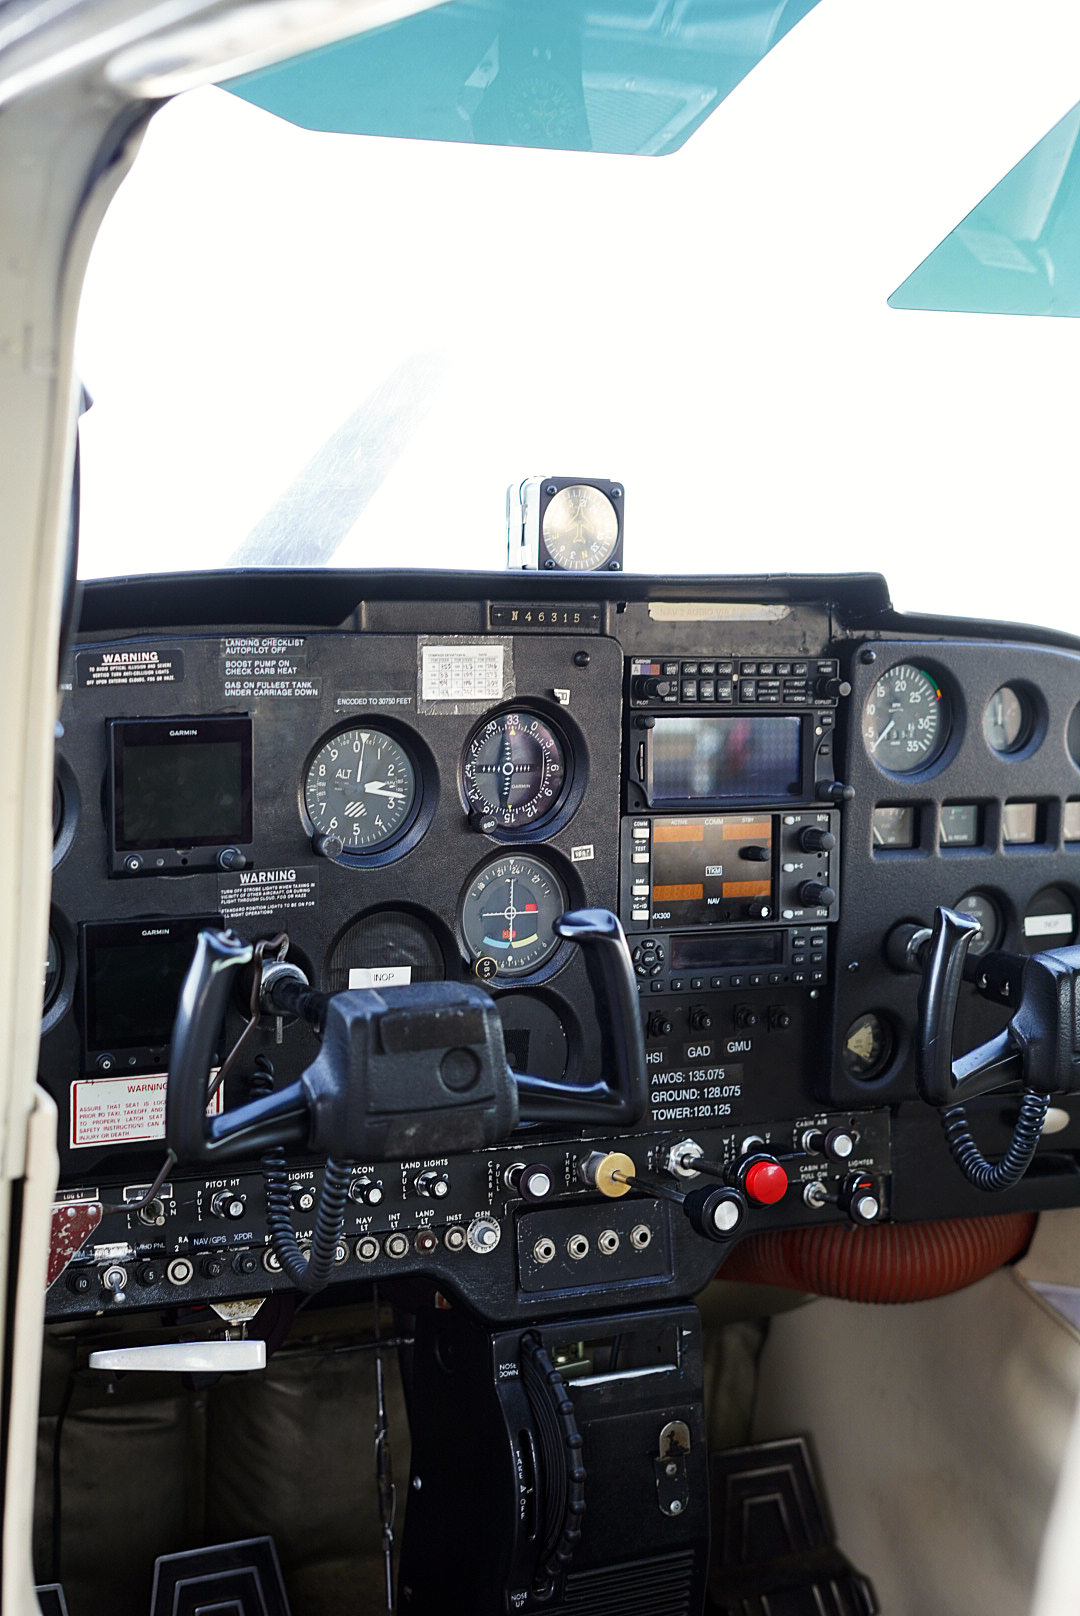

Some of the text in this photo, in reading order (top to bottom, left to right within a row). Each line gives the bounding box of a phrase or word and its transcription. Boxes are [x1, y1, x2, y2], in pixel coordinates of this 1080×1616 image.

[103, 652, 158, 663] WARNING
[895, 681, 906, 691] 20
[877, 687, 885, 697] 15
[909, 692, 921, 703] 25
[867, 704, 875, 715] 10
[506, 715, 519, 725] 33
[531, 721, 538, 730] 0
[918, 718, 929, 729] 30
[486, 721, 497, 734] 30
[353, 741, 360, 752] 0
[471, 740, 479, 753] 27
[546, 740, 554, 748] 3
[907, 741, 918, 752] 35
[331, 749, 338, 761] 9
[319, 765, 326, 776] 8
[388, 765, 394, 776] 2
[465, 764, 472, 778] 24
[551, 764, 559, 772] 6
[336, 769, 352, 779] ALT
[387, 797, 395, 809] 3
[320, 803, 326, 815] 7
[526, 805, 538, 817] 12
[330, 817, 338, 828] 6
[375, 815, 383, 826] 4
[504, 813, 515, 823] 15
[353, 824, 360, 835] 5
[512, 866, 520, 874] 24
[240, 870, 296, 883] WARNING
[374, 973, 394, 981] INOP
[727, 1040, 751, 1052] GMU
[688, 1046, 710, 1058] GAD
[646, 1052, 662, 1064] HSI
[652, 1069, 725, 1085] AWOS: 135.075
[652, 1085, 741, 1103] GROUND: 128.075
[103, 1123, 144, 1131] INSTRUCTIONS
[401, 1159, 448, 1170] LAND LIGHTS
[848, 1159, 873, 1167] LIGHTER
[289, 1172, 314, 1180] LIGHTS
[206, 1180, 226, 1188] PITOT
[389, 1213, 400, 1221] INT
[416, 1210, 434, 1218] LAND
[356, 1217, 372, 1225] NAV
[234, 1232, 253, 1241] XPDR
[295, 1230, 313, 1239] FLAP
[194, 1236, 226, 1245] NAV/GPS
[79, 1280, 87, 1288] 10
[511, 1592, 527, 1602] NOSE
